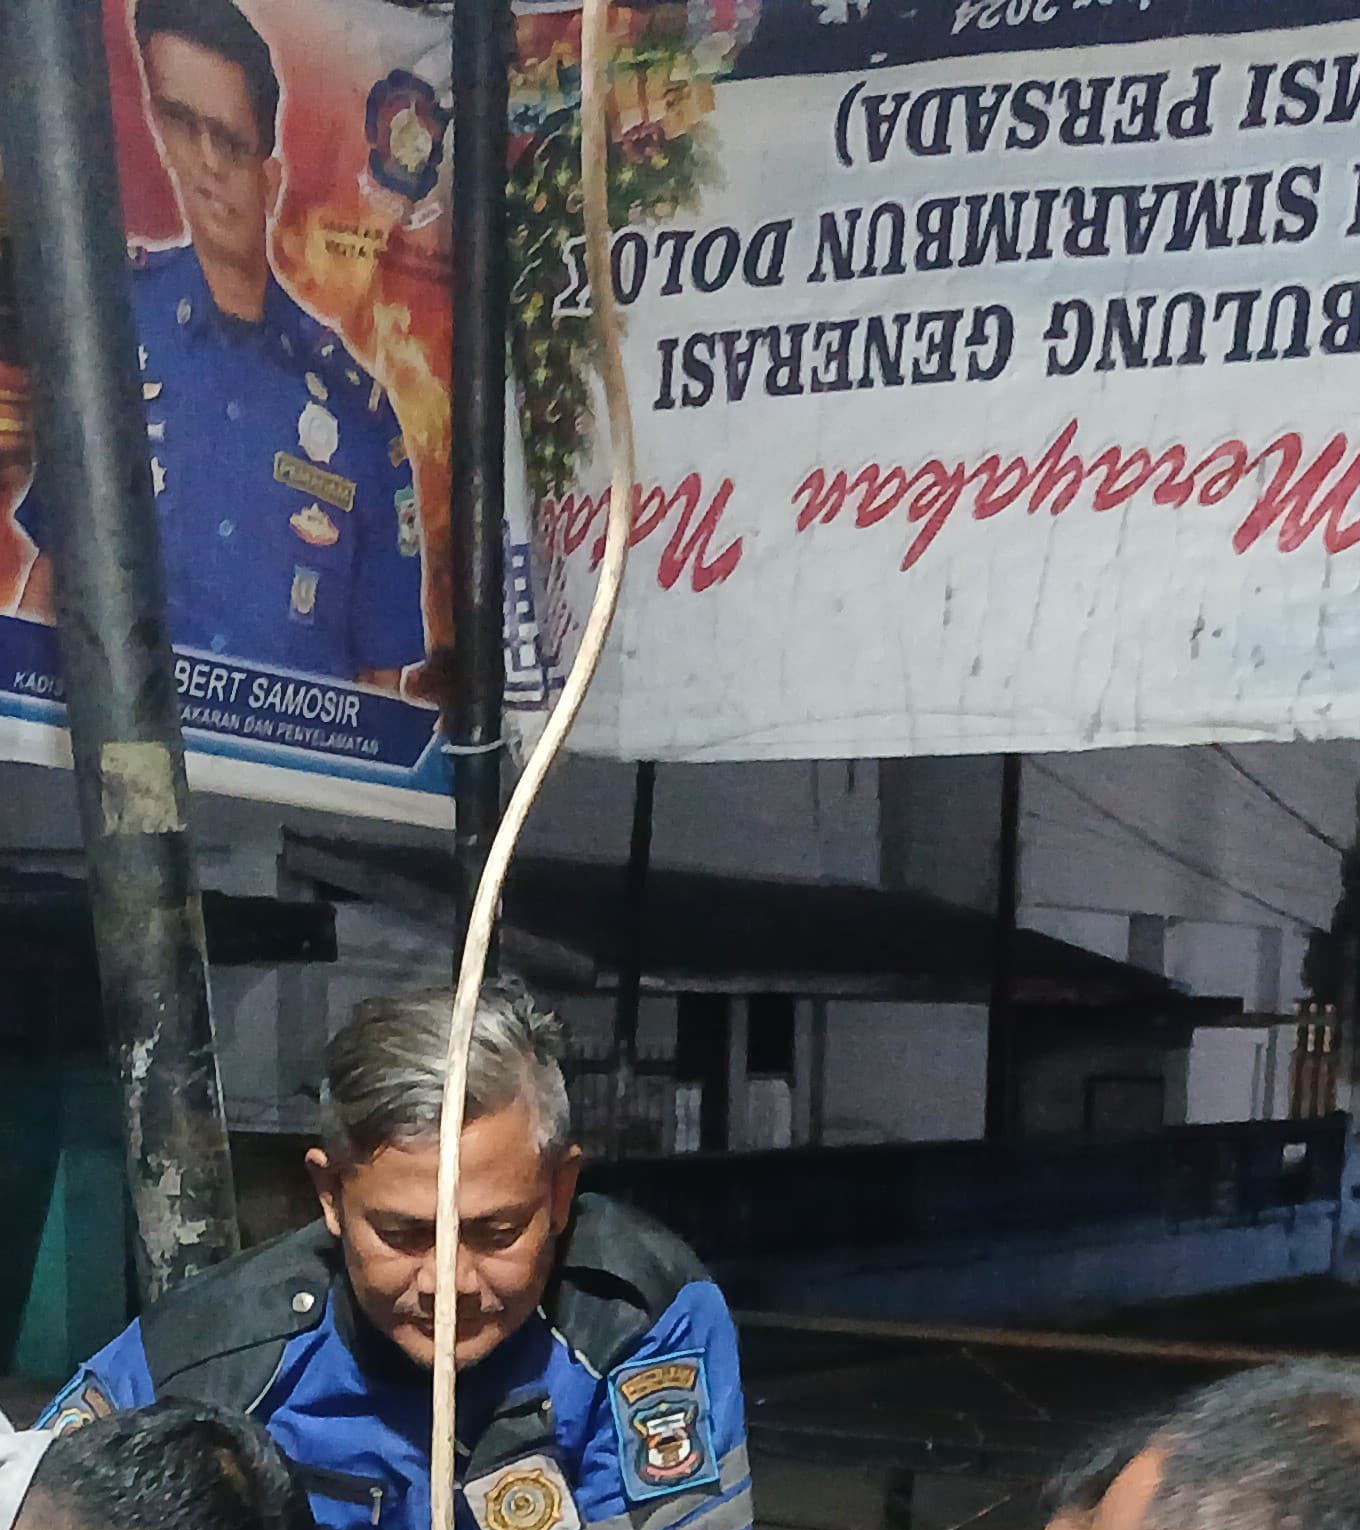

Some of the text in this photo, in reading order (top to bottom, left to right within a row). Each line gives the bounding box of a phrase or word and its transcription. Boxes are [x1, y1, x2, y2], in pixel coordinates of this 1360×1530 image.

[833, 64, 1220, 168] PERSADA)
[807, 165, 1320, 283] SIMARIMBUN
[651, 305, 1014, 410] GENERASI
[244, 715, 274, 736] DAN
[248, 676, 360, 728] SAMOSIR
